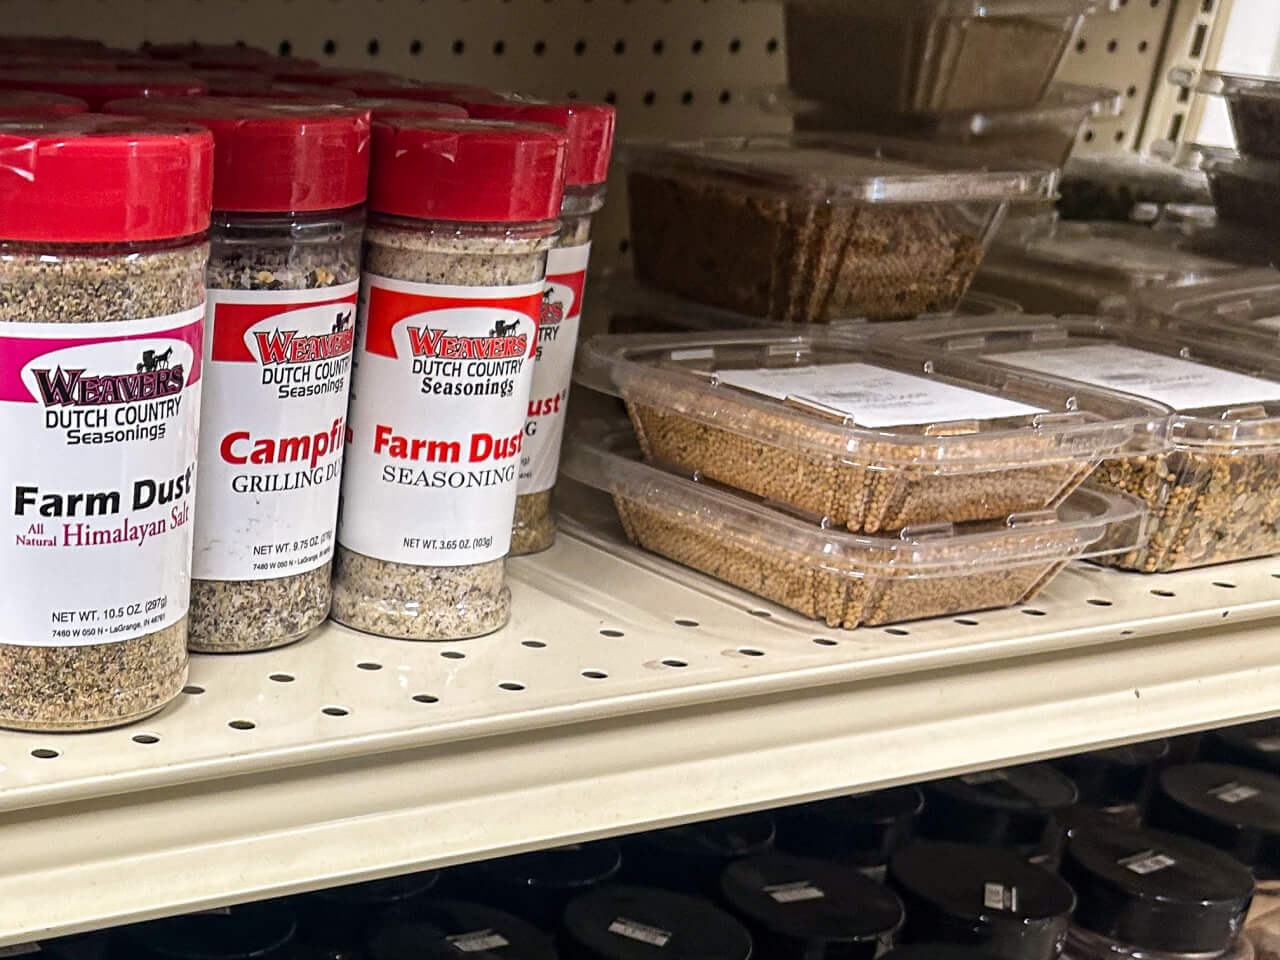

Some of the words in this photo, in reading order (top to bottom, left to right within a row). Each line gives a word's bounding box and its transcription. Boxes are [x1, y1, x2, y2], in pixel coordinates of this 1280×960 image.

[407, 325, 527, 360] WEAVERS
[262, 366, 310, 384] DUTCH
[413, 359, 461, 376] DUTCH
[468, 359, 523, 376] COUNTRY
[31, 365, 185, 406] WEAVERS
[279, 378, 343, 398] Seasonings
[421, 377, 514, 397] Seasonings
[46, 408, 107, 429] DUTCH
[115, 397, 181, 426] COUNTRY
[528, 393, 560, 417] ust
[67, 423, 166, 445] Seasonings
[221, 417, 345, 468] Campfi
[374, 424, 460, 463] Farm
[470, 429, 523, 463] Dust
[232, 467, 323, 494] GRILLING
[383, 464, 514, 488] SEASONING
[14, 486, 119, 517] Farm
[16, 534, 56, 547] Natural
[63, 516, 166, 548] Himalayan
[170, 502, 188, 529] Salt
[28, 524, 43, 535] All
[404, 537, 420, 548] NET
[440, 540, 457, 549] 3.65
[52, 611, 77, 623] NET
[79, 610, 100, 622] WT.
[104, 607, 124, 620] 10.5
